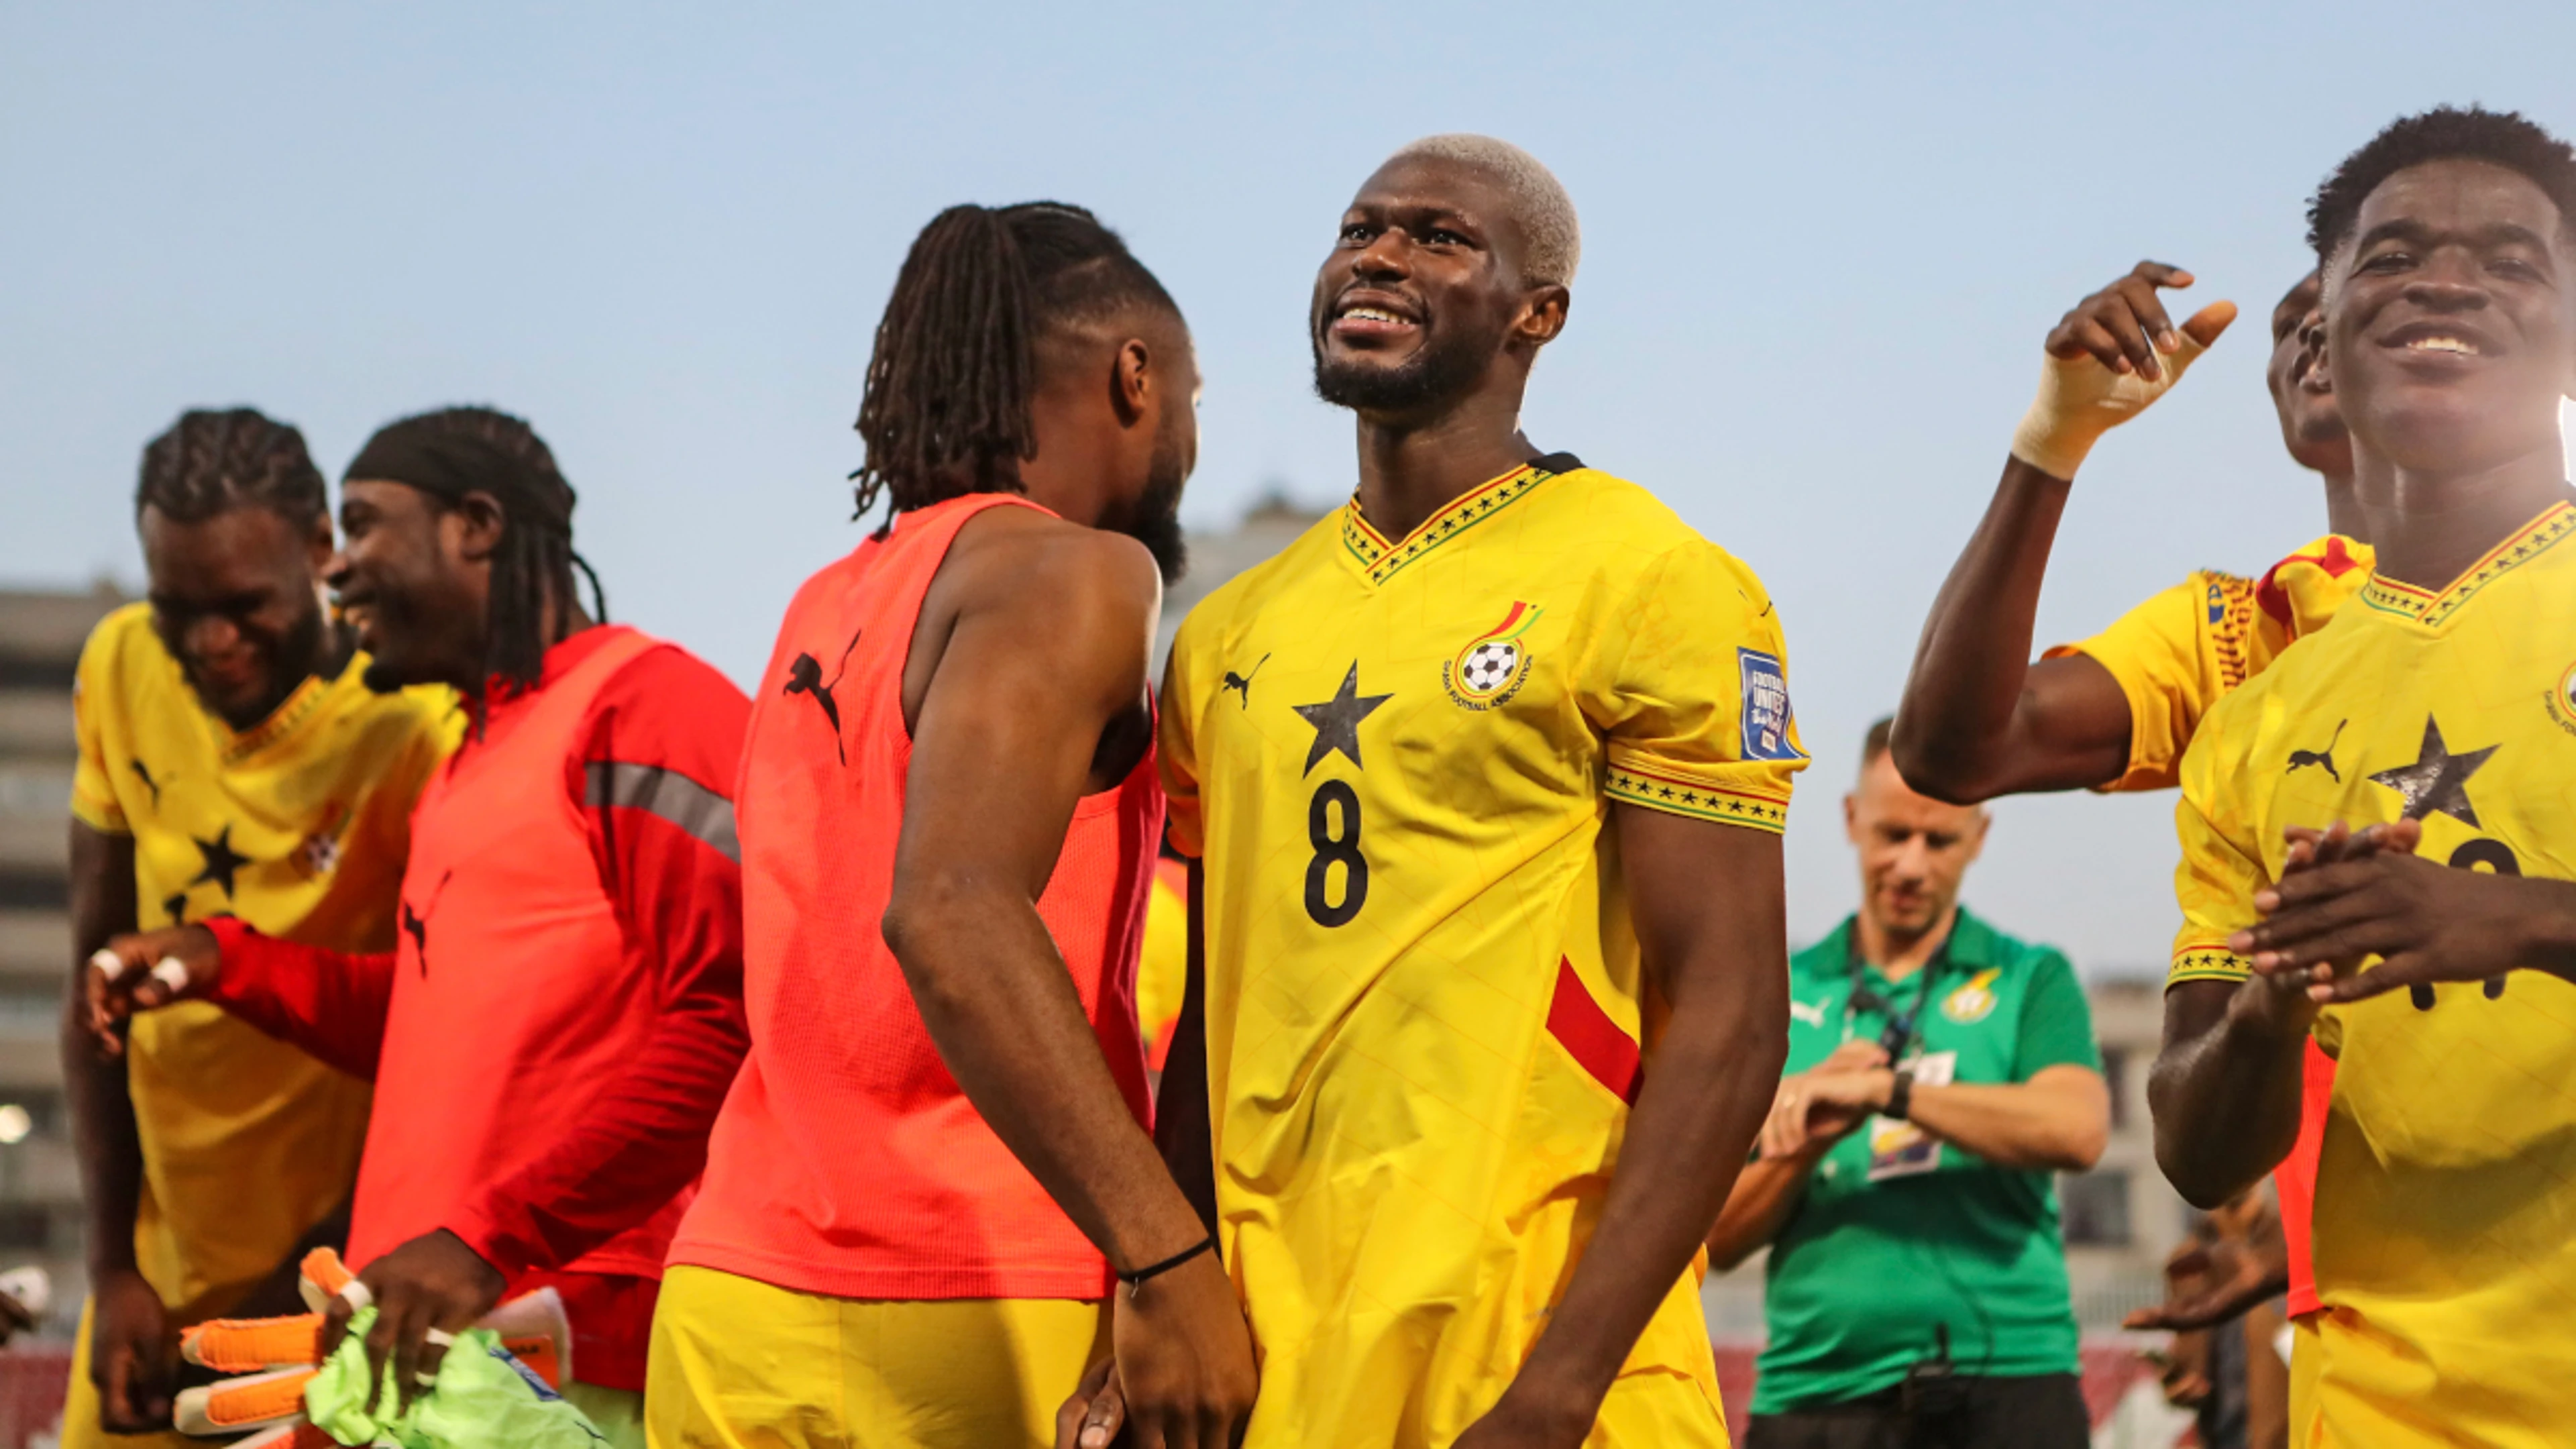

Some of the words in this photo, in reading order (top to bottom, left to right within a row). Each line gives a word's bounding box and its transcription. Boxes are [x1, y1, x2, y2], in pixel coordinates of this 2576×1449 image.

[1448, 690, 1488, 711] FOOTBALL
[1491, 655, 1532, 707] ASSOCIATION
[1304, 779, 1368, 928] 8
